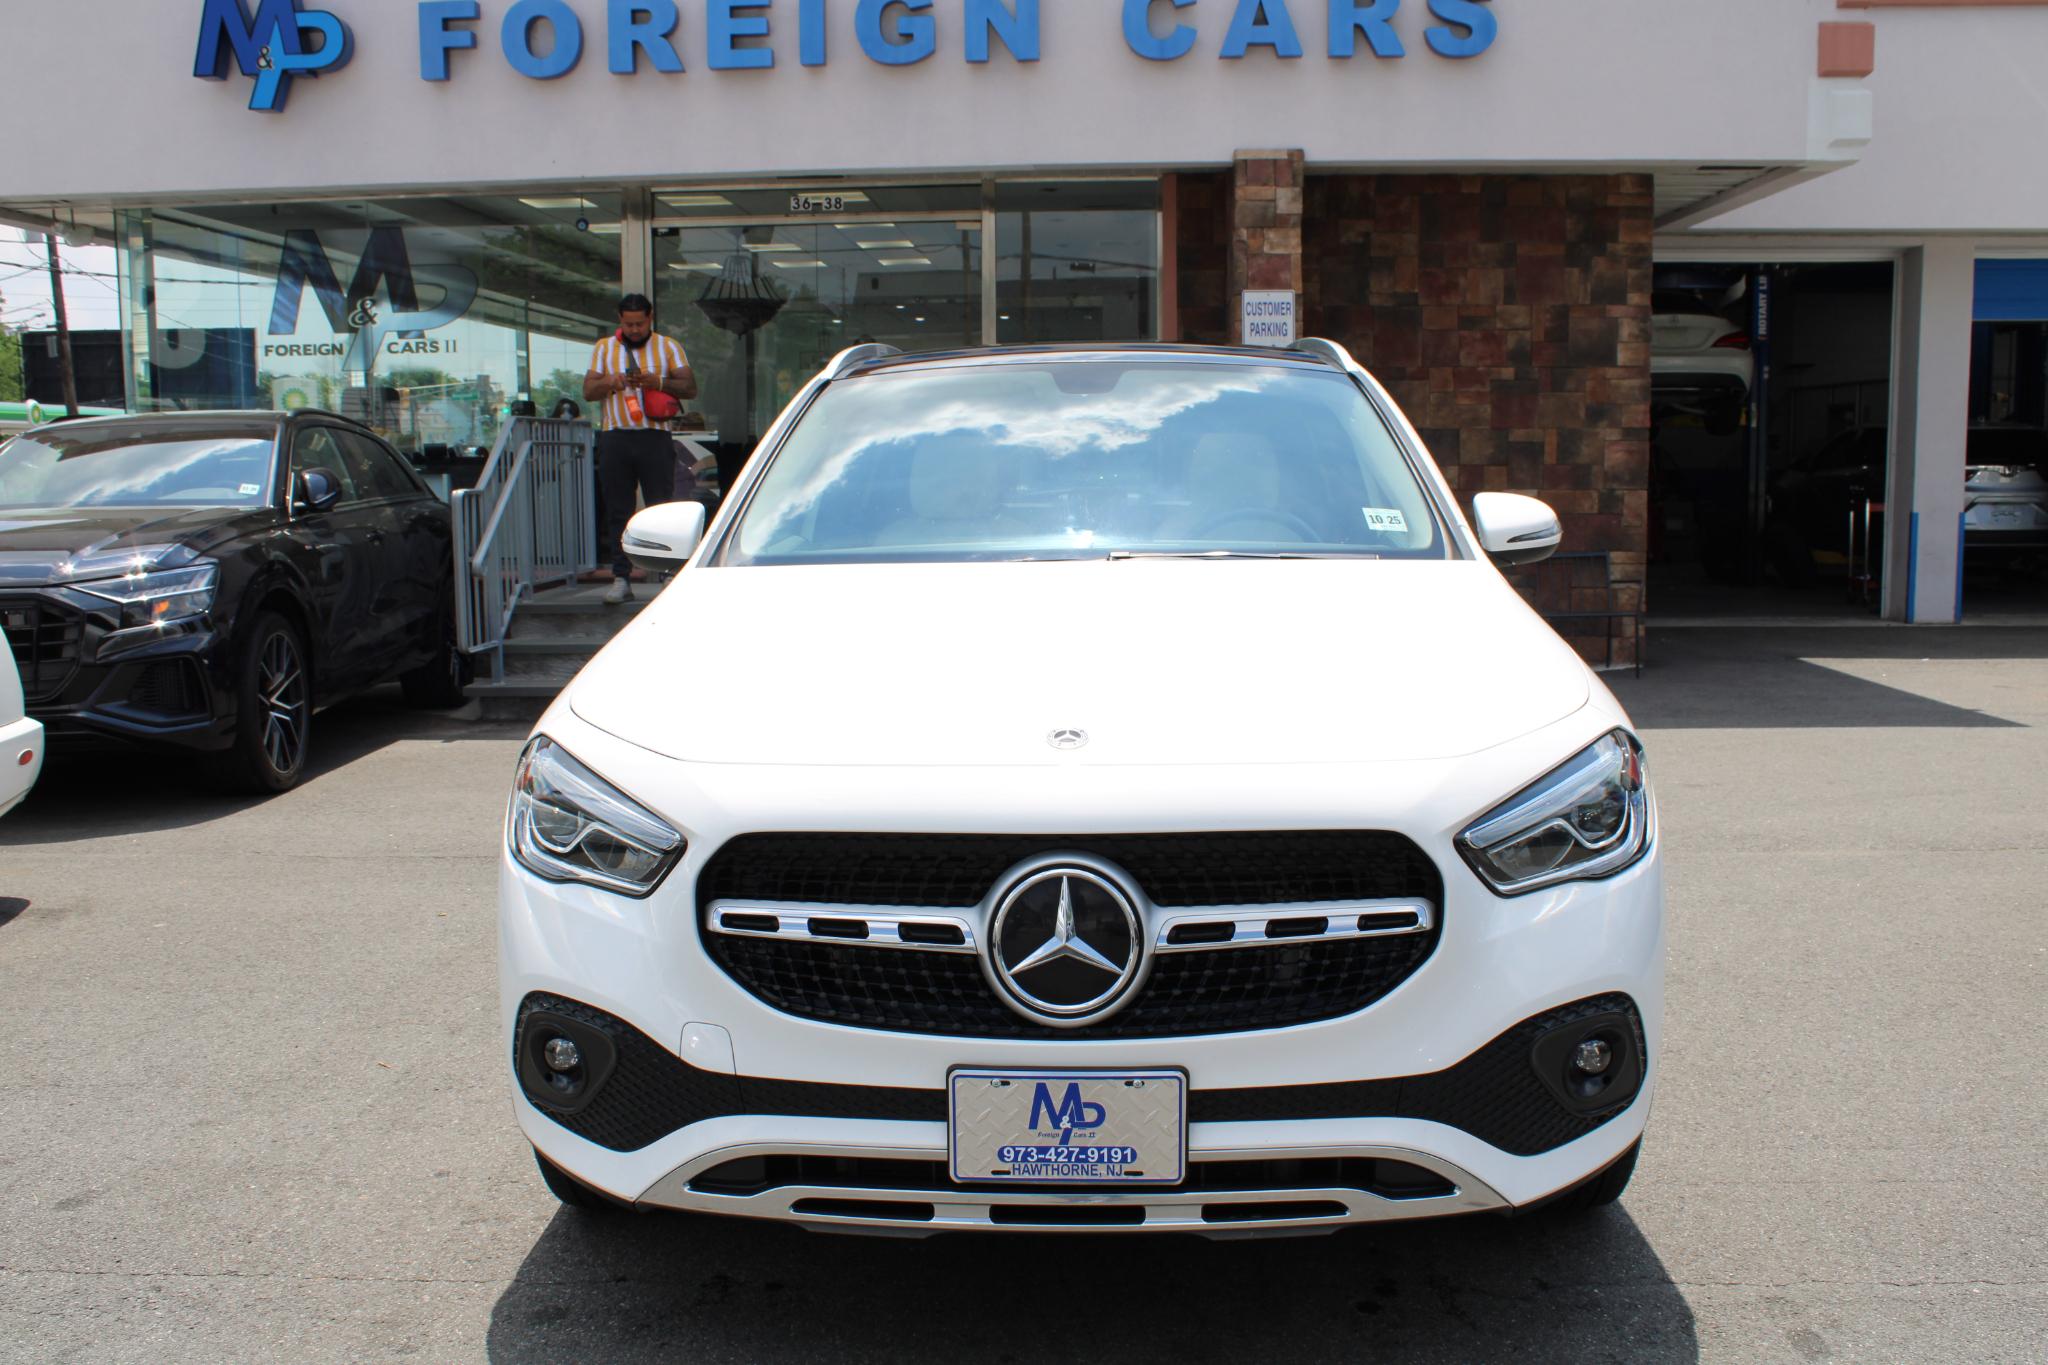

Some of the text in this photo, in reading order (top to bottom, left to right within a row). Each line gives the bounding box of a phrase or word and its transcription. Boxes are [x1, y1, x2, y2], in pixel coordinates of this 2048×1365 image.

[418, 0, 1041, 82] FOREIGN
[1121, 0, 1498, 61] CARS
[791, 196, 843, 210] 36-38
[1245, 301, 1292, 316] CUSTOMER
[1757, 293, 1768, 335] ROTARY
[1249, 322, 1288, 337] PARKING
[264, 343, 344, 357] FOREIGN
[386, 339, 440, 354] CARS
[1368, 514, 1401, 525] 10 25
[1003, 1147, 1133, 1162] 973-427-9191
[1012, 1163, 1123, 1177] HAWTHORNE, NJ
